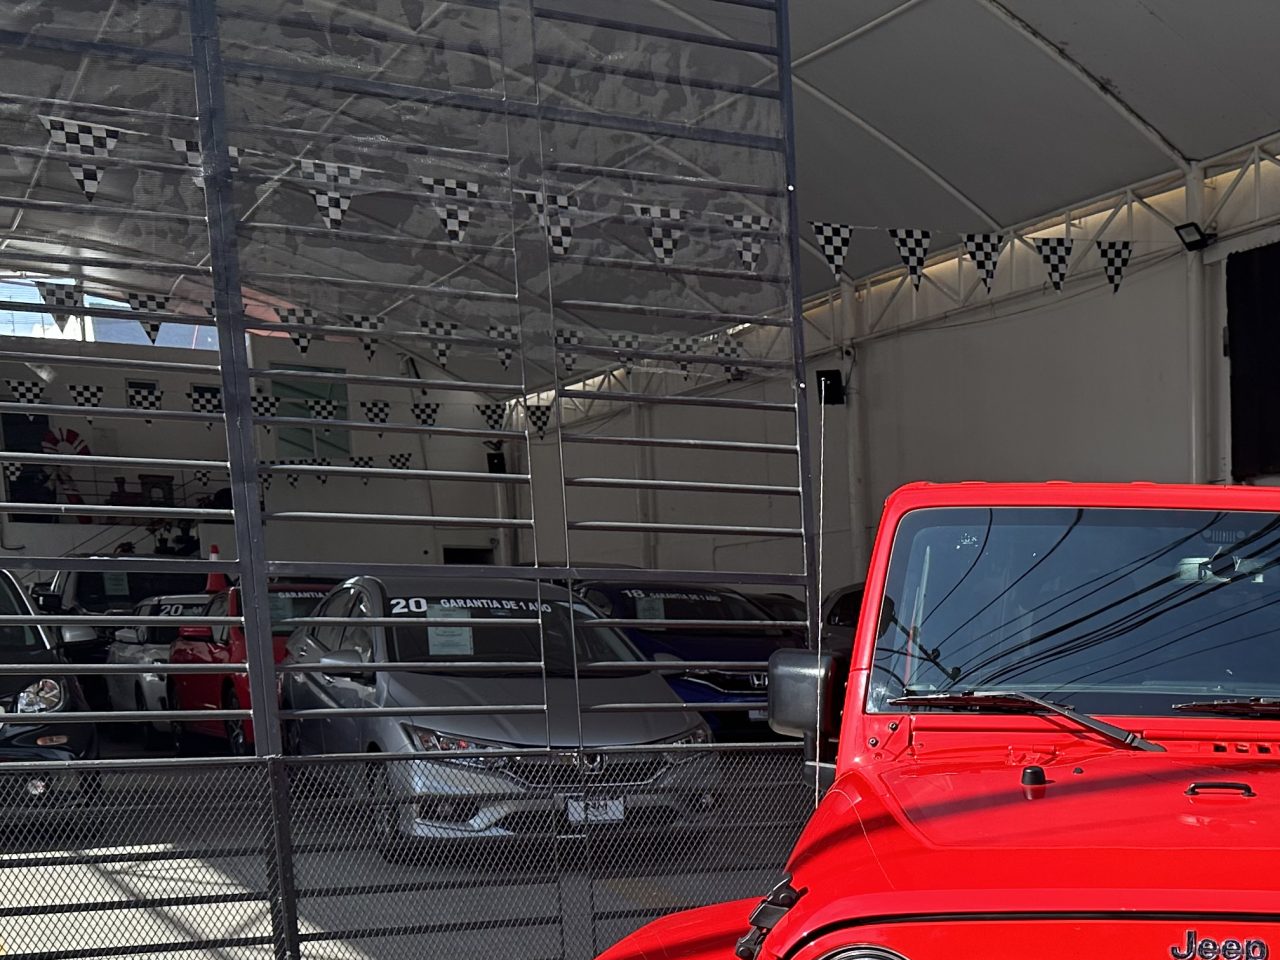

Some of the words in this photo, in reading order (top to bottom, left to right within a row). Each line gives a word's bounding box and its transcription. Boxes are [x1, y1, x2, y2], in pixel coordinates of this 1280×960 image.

[278, 591, 324, 599] GARANTIA
[159, 604, 183, 616] 20
[390, 597, 428, 614] 20
[440, 599, 501, 609] GARANTIA
[503, 600, 519, 609] DE
[519, 602, 527, 610] 1
